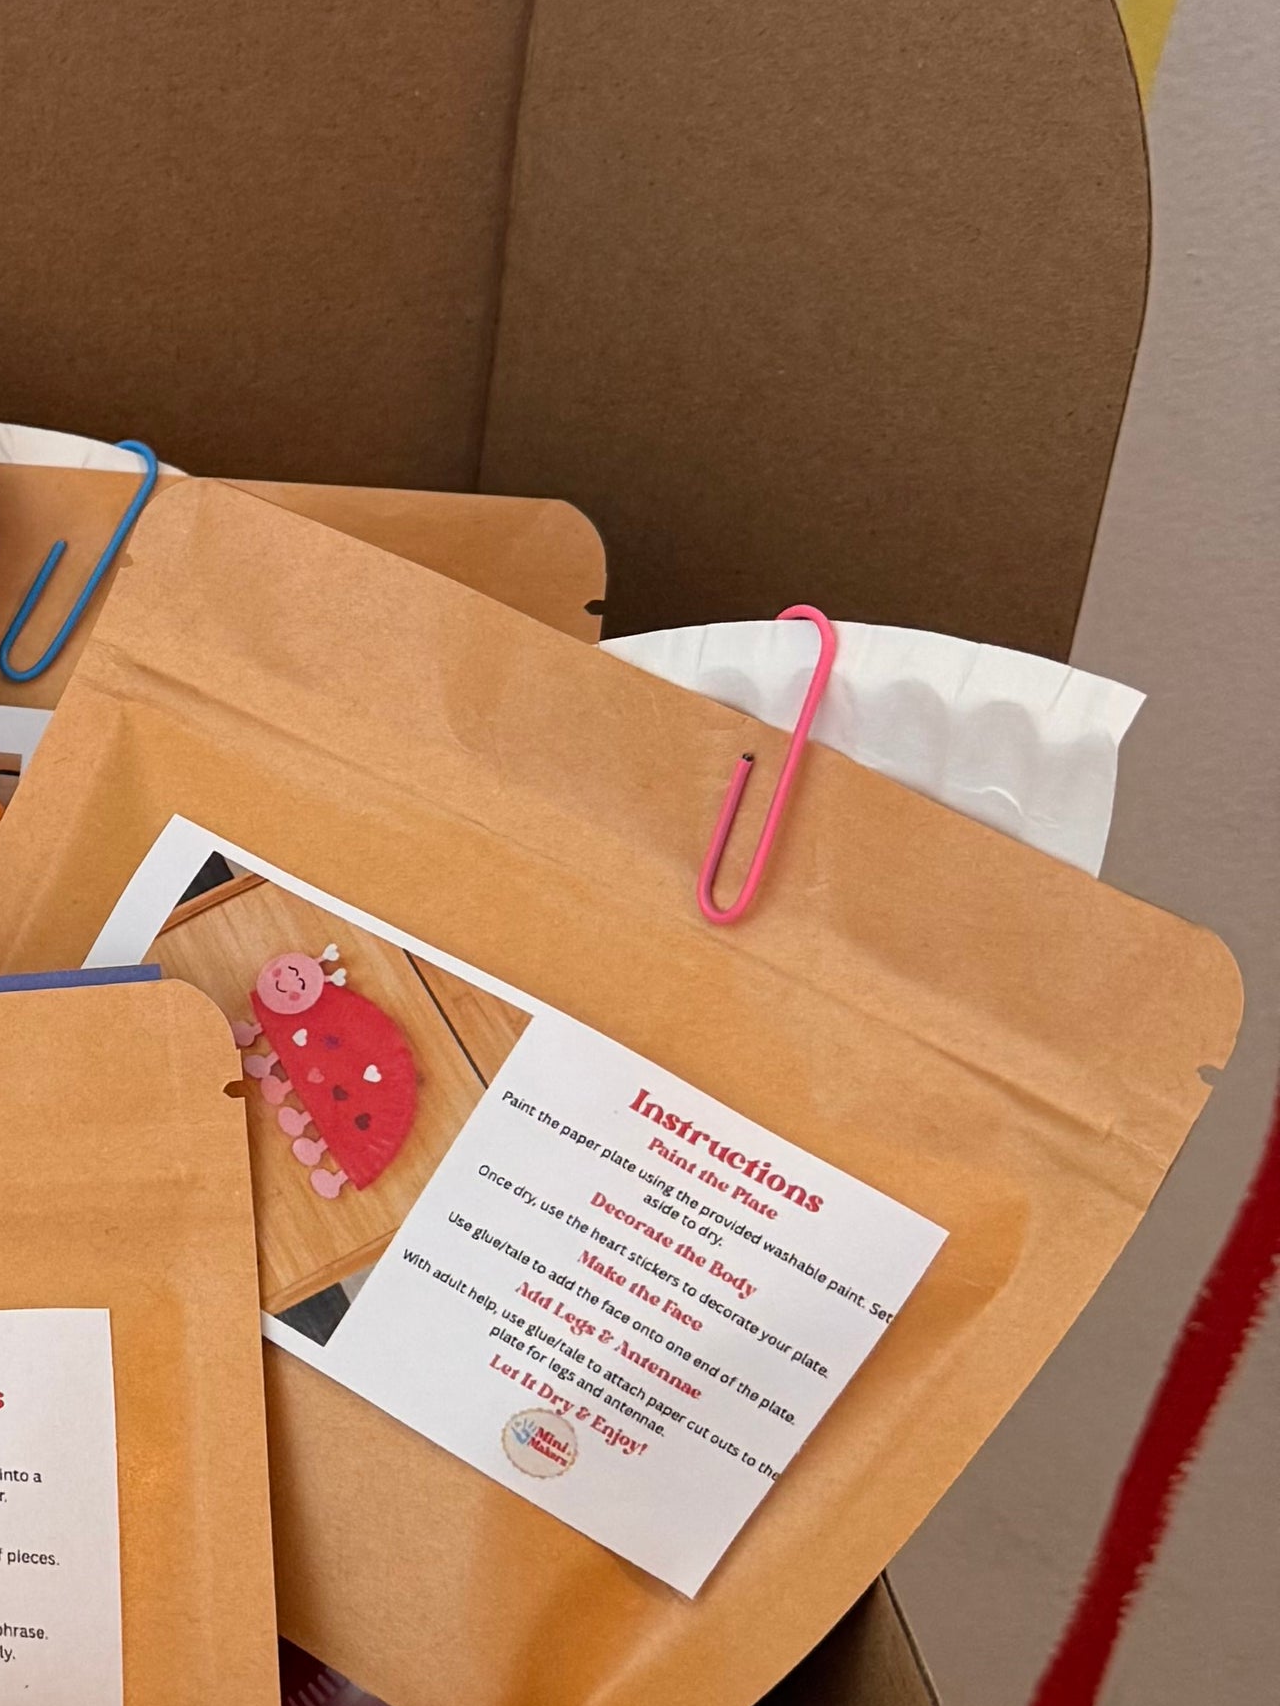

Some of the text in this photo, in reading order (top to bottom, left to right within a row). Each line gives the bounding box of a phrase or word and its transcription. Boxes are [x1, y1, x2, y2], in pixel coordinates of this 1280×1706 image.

[628, 1088, 824, 1213] Instructions
[647, 1136, 778, 1220] Paint the Plate
[501, 1090, 893, 1324] Paint the paper plate using the provided washable paint. Set
[589, 1191, 757, 1299] Decorate the Body
[642, 1194, 723, 1247] aside to dry.
[478, 1164, 828, 1379] Once dry, use the heart stickers to decorate your plate.
[576, 1249, 703, 1331] Make the Face
[514, 1281, 702, 1399] Add Legs & Antennae
[488, 1353, 648, 1456] Let It Dry & Enjoy!
[0, 1467, 29, 1482] into
[32, 1472, 42, 1483] a
[7, 1549, 59, 1565] pieces.
